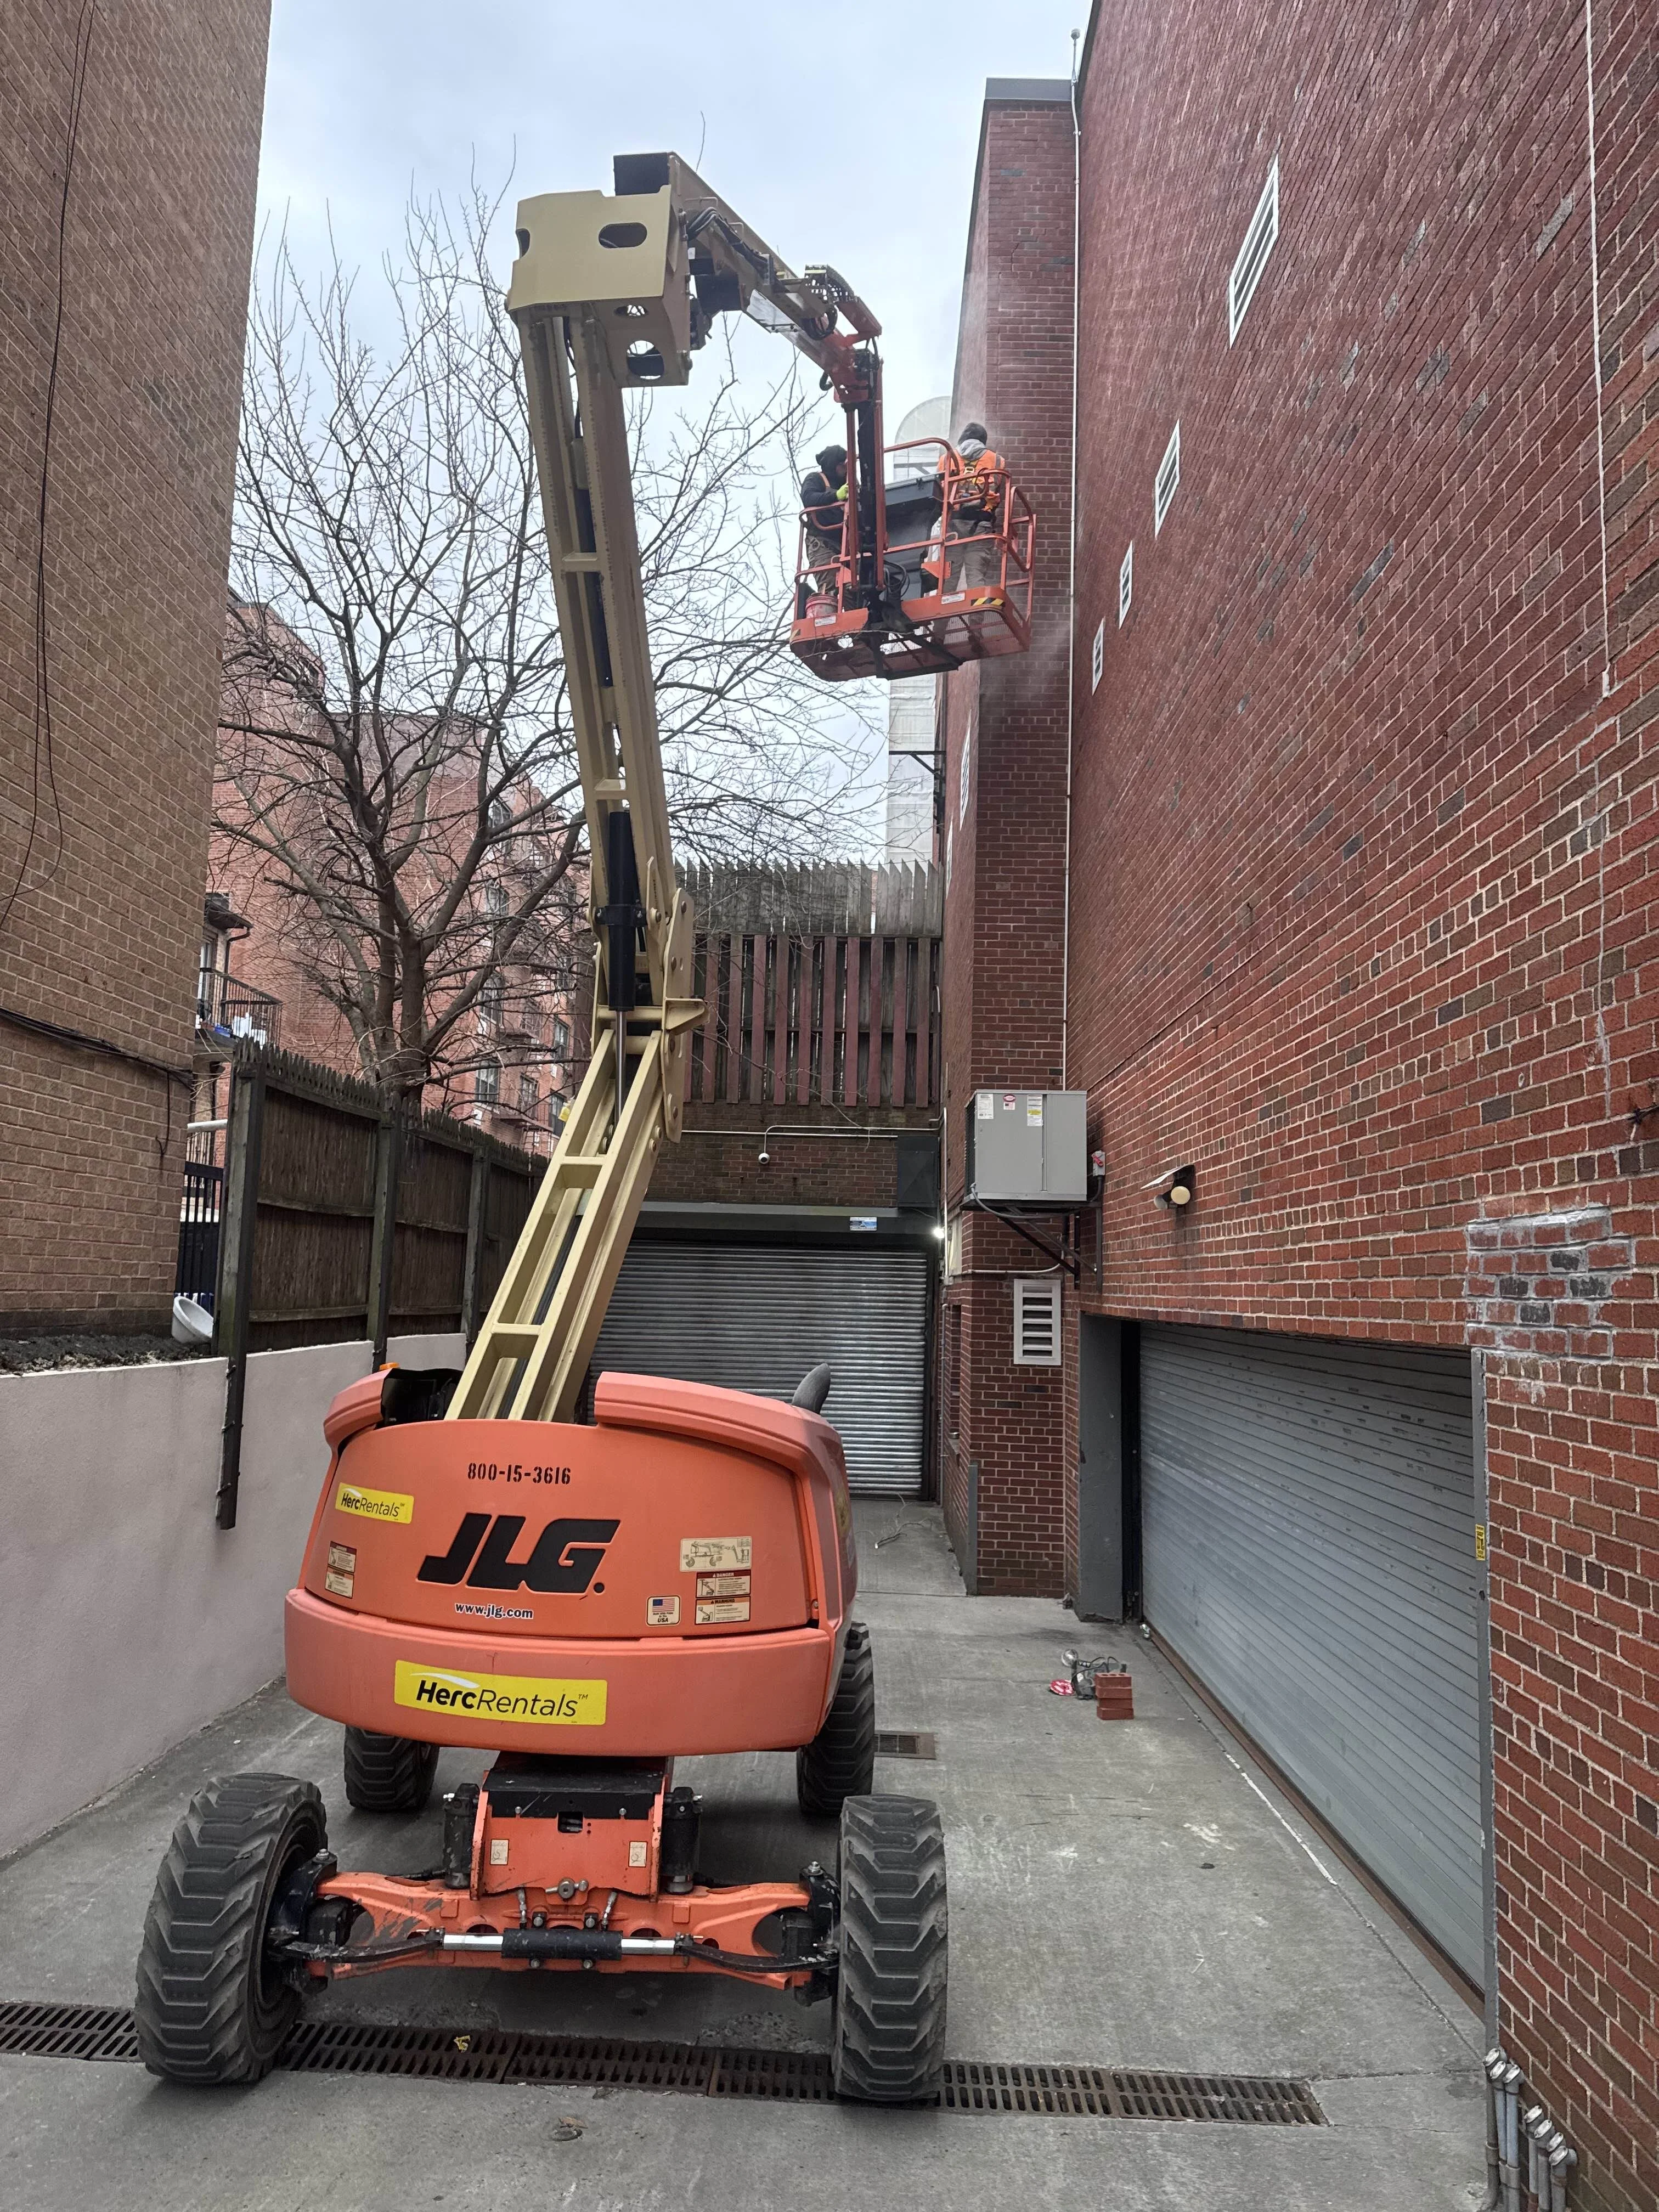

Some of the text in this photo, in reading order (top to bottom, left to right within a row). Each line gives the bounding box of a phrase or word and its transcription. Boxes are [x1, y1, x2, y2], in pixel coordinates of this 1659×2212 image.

[467, 1463, 571, 1485] 800-15-3616
[341, 1492, 400, 1517] HercRentals
[455, 1604, 533, 1618] www.jlg.com
[416, 1679, 578, 1717] HercRentals
